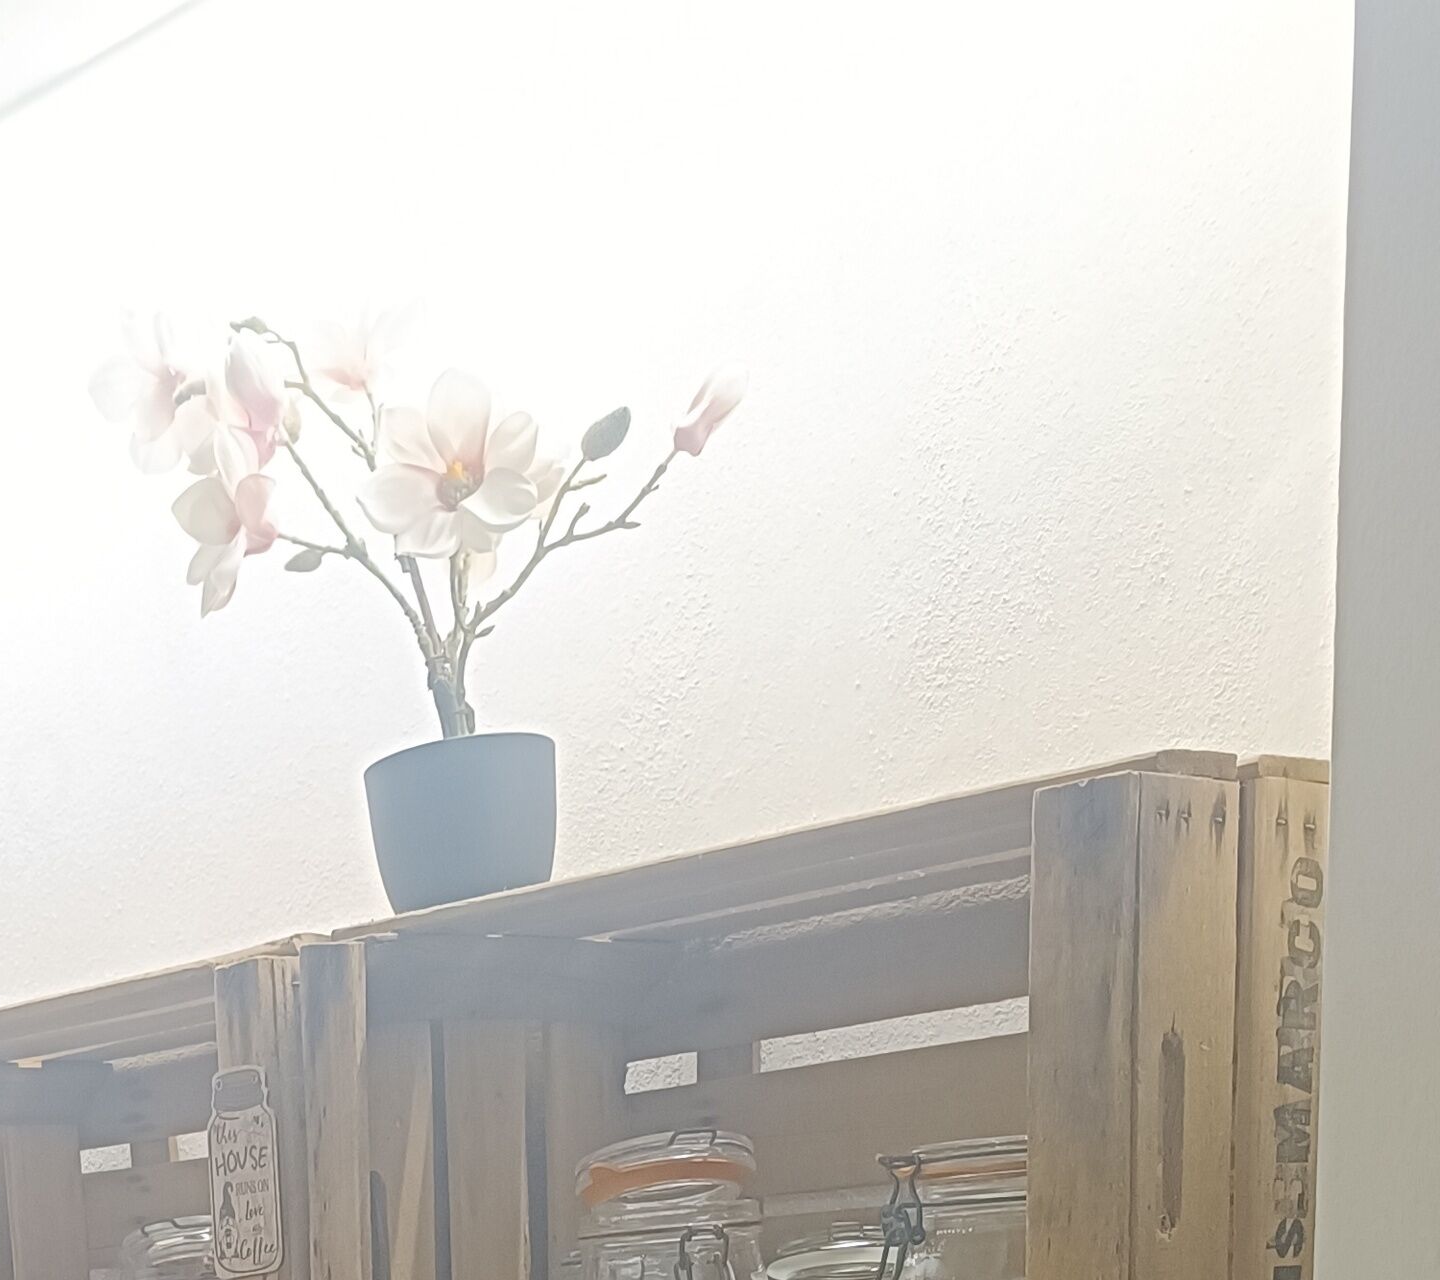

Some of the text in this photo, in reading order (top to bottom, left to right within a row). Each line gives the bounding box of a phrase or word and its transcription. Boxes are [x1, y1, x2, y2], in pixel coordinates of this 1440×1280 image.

[1275, 856, 1325, 1165] MARCO
[214, 1144, 268, 1177] HOUSE
[235, 1178, 270, 1197] RUNS ON
[245, 1200, 264, 1221] Love
[239, 1236, 277, 1266] Coffee
